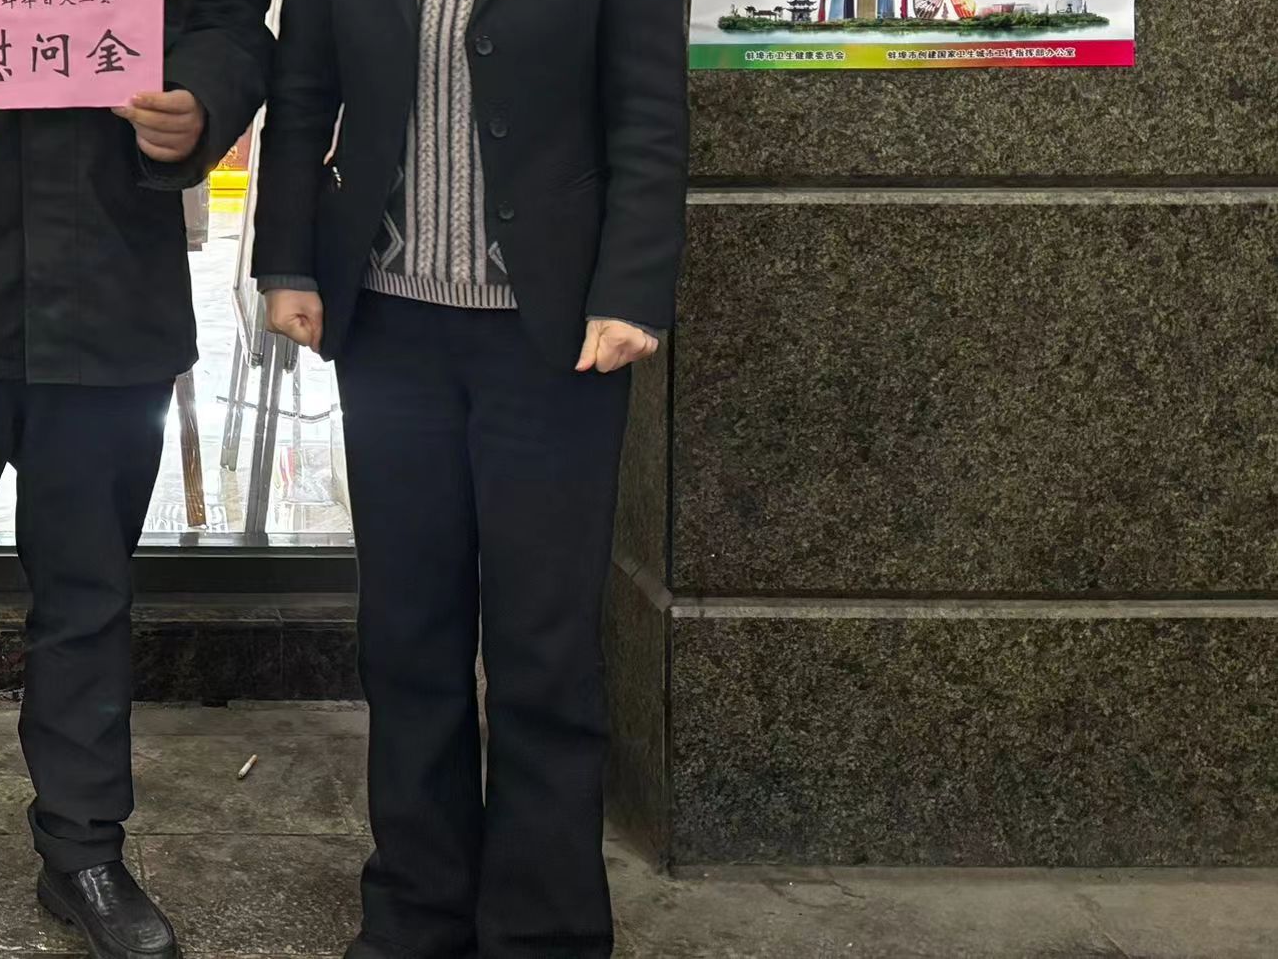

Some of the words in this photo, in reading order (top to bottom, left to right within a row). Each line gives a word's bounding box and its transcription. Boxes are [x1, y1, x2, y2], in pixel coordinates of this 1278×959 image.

[744, 49, 845, 61] 蚌埠市卫生健康委员会
